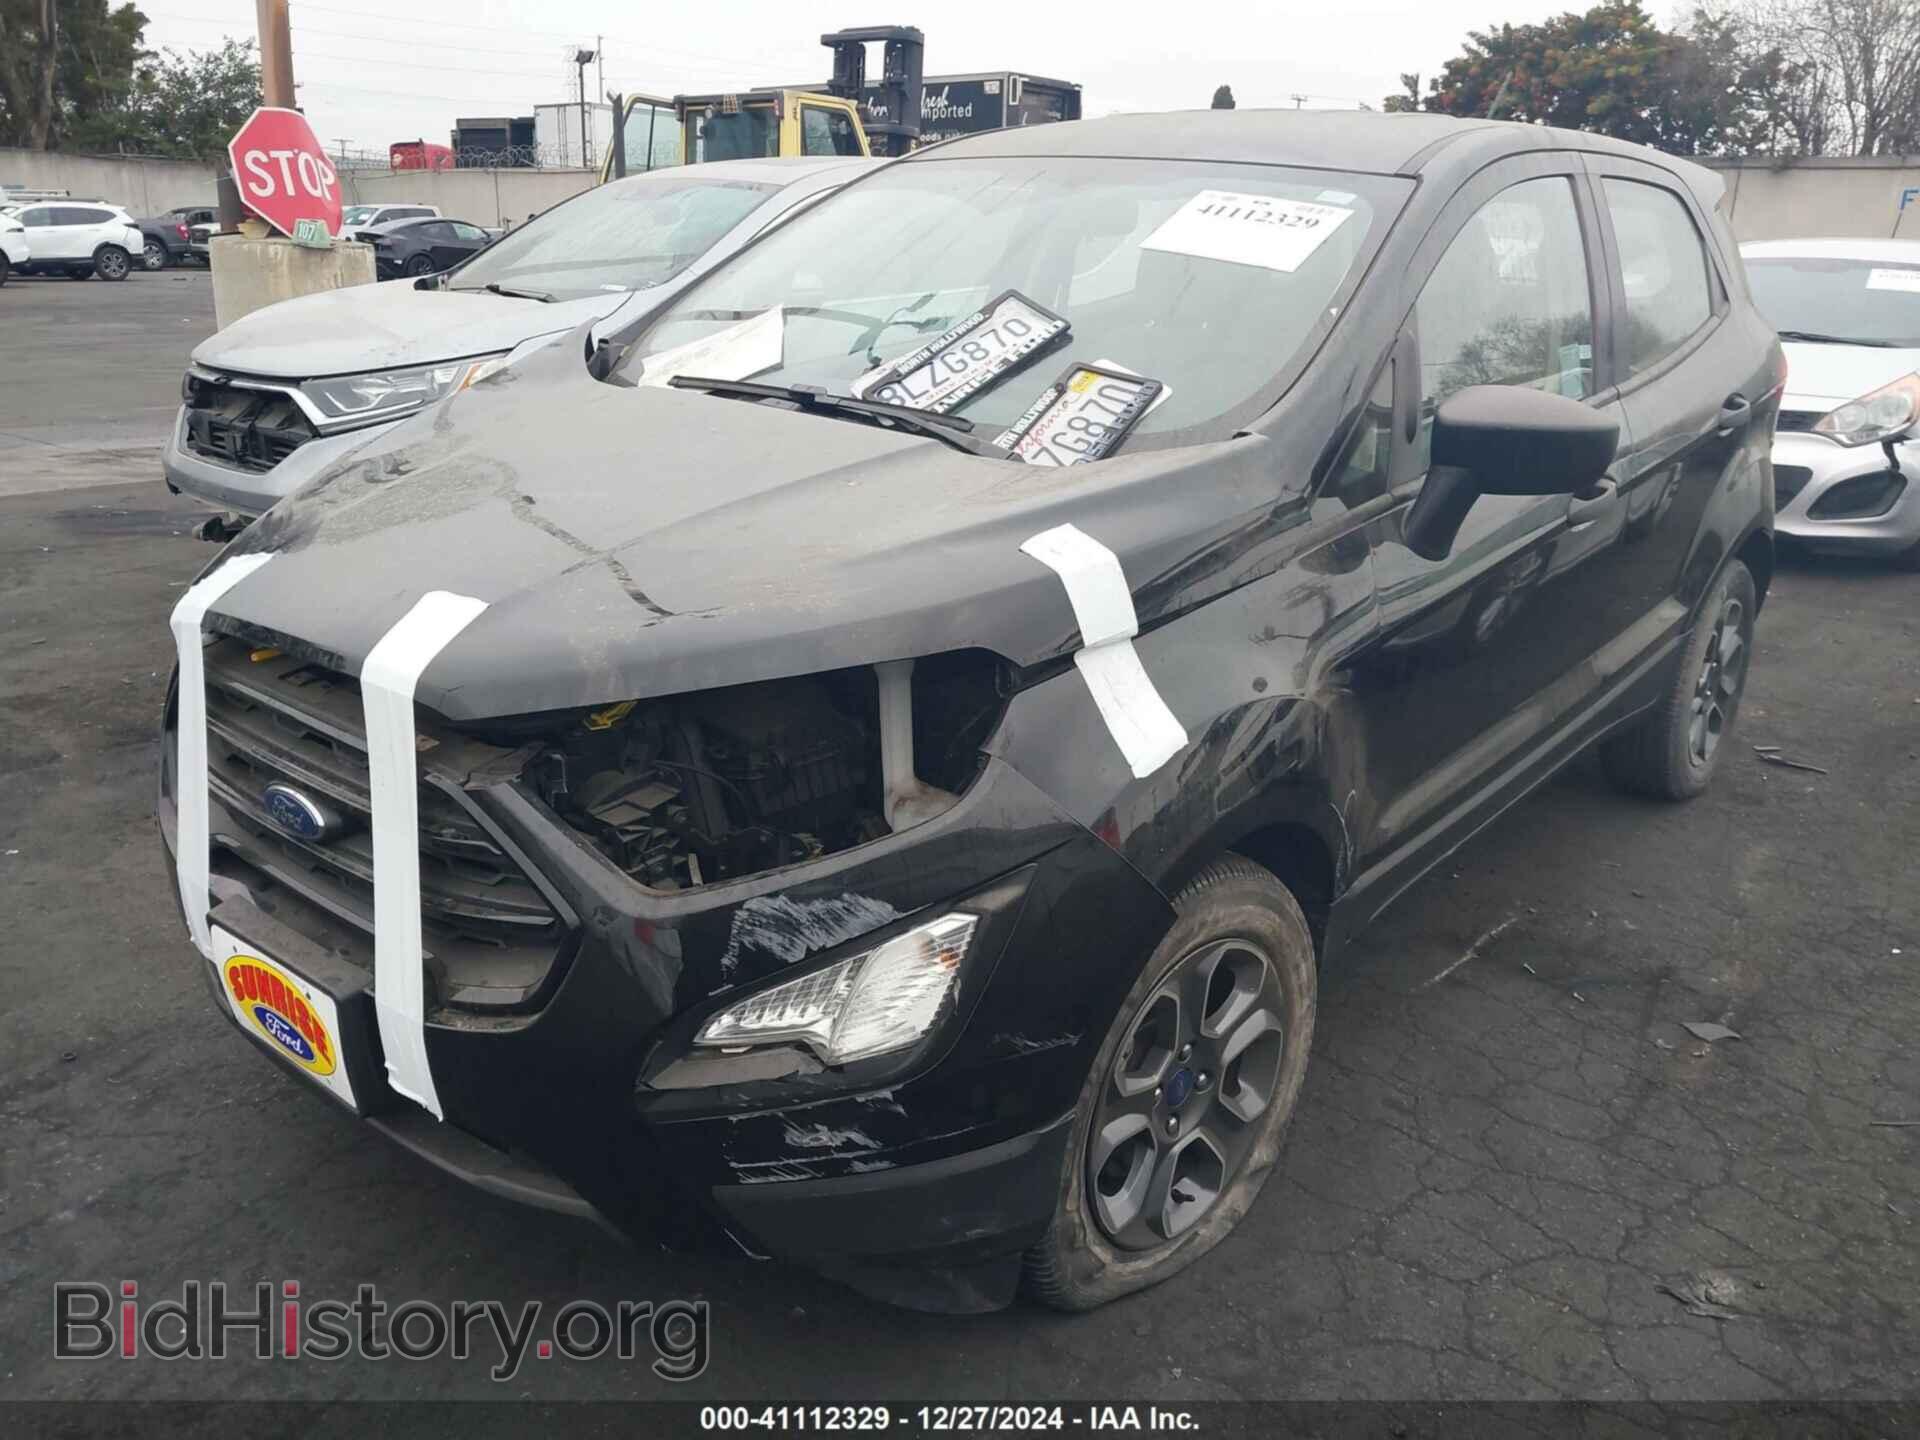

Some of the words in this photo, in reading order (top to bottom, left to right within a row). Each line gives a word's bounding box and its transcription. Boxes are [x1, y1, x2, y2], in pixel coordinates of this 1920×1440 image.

[920, 101, 973, 121] mported
[244, 150, 335, 200] STOP
[298, 221, 315, 239] 107
[1197, 203, 1320, 228] 41112329
[873, 317, 1031, 407] 8LZG870
[228, 964, 332, 1067] SUNRISE
[265, 1012, 304, 1055] Ford
